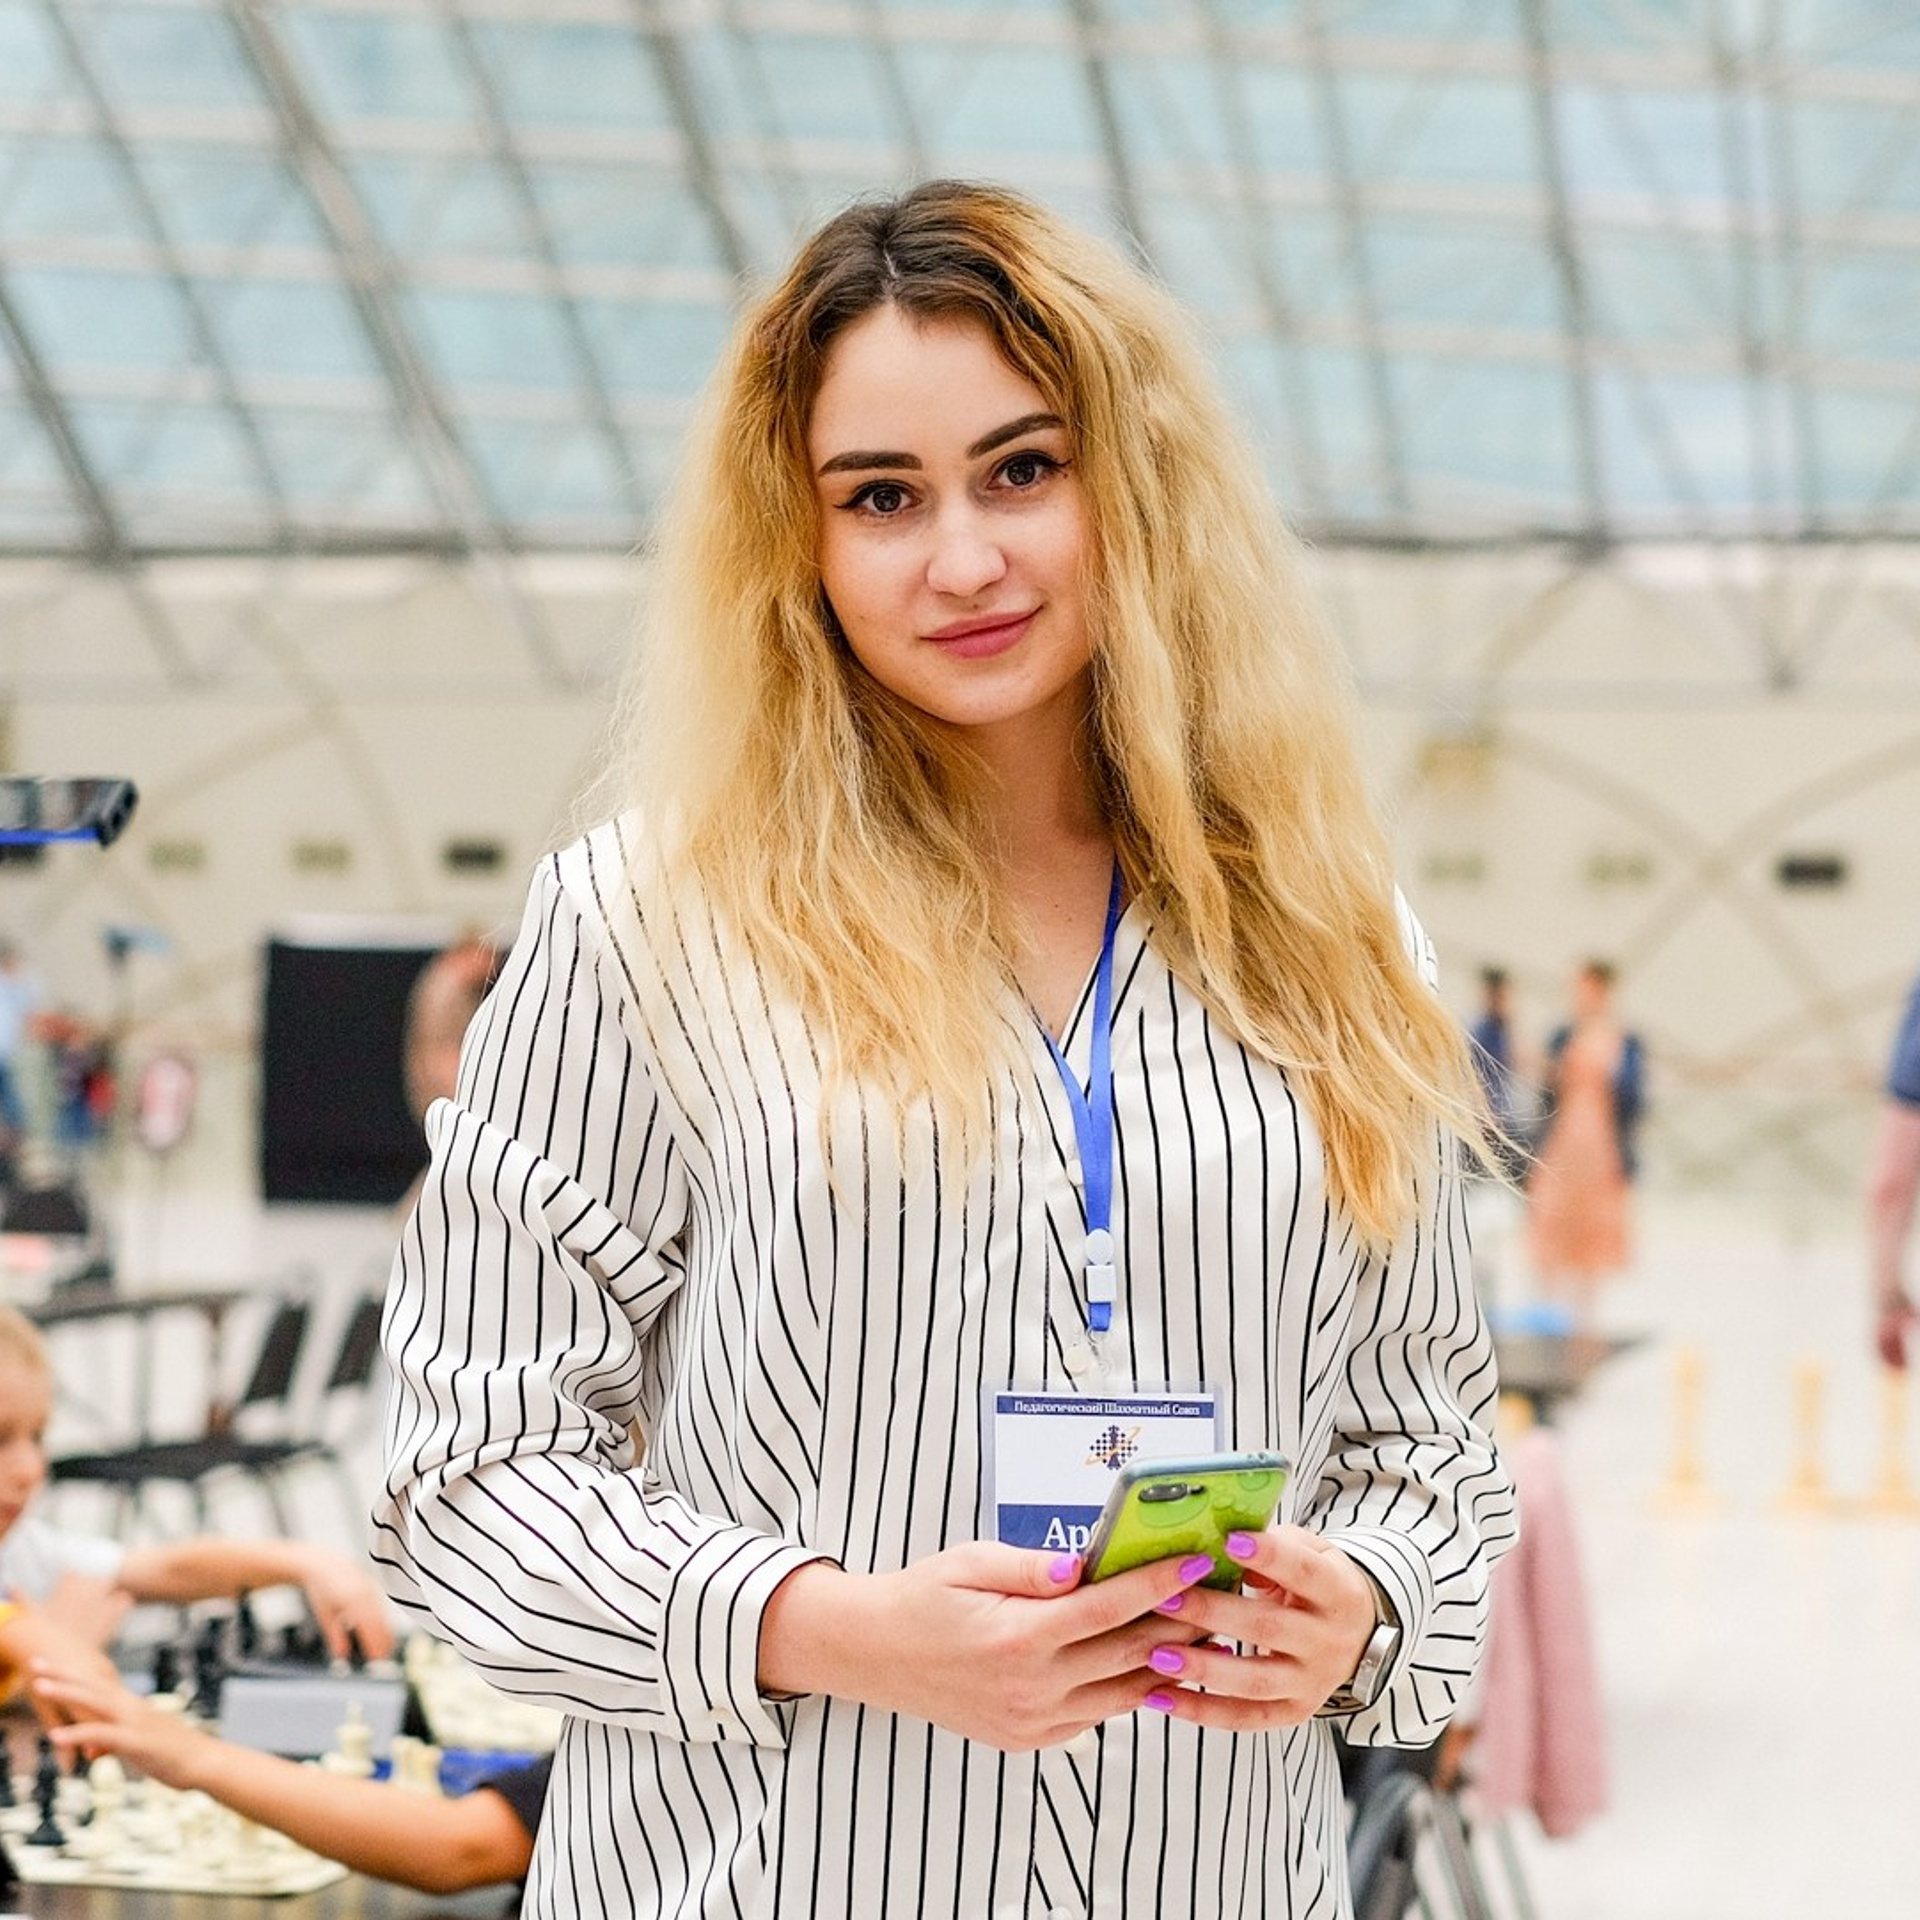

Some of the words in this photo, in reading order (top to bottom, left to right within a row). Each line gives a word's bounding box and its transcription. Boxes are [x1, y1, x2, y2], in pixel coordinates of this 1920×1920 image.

[1014, 1400, 1103, 1414] Педагогический
[1104, 1403, 1171, 1415] Шахматный
[1172, 1404, 1201, 1416] Союз
[1042, 1517, 1099, 1554] Ар
